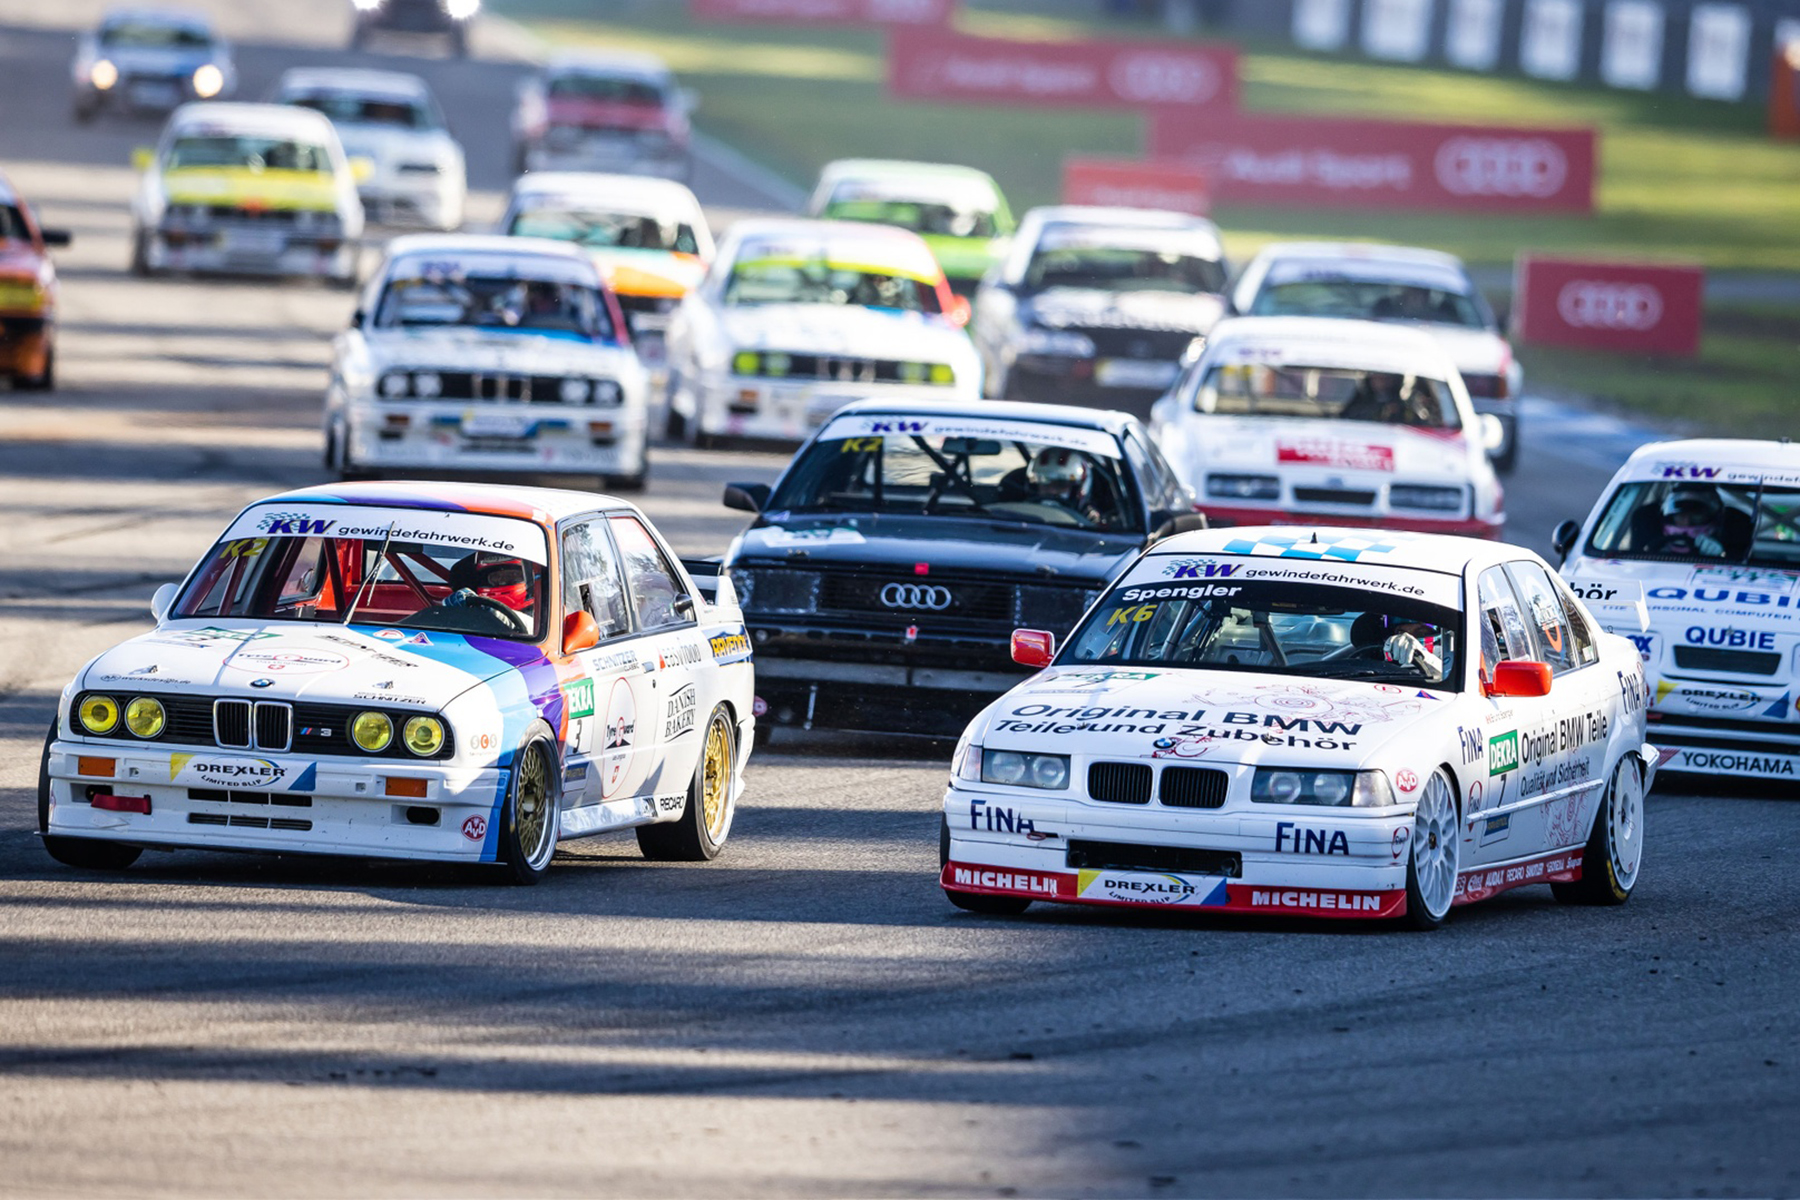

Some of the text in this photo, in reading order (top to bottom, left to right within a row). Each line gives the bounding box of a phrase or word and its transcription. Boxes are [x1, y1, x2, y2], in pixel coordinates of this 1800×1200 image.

[841, 436, 884, 453] K2
[267, 519, 515, 551] KW gewindefahrwerk.de
[219, 538, 269, 559] K2
[1173, 564, 1426, 597] KW gewindefahrwerk.de
[1122, 584, 1242, 602] Spengler
[1647, 587, 1800, 609] QUBI
[1106, 605, 1158, 626] K6
[1685, 626, 1777, 650] QUBIE
[592, 650, 638, 672] SCHNITZER
[667, 689, 696, 718] DANISH
[1681, 688, 1763, 702] DREXLER
[664, 708, 696, 738] BAKERY
[1012, 704, 1363, 736] Original BMW
[573, 719, 583, 754] 3
[994, 719, 1358, 751] Teile und Zubehör
[1457, 725, 1484, 765] FINA
[1521, 709, 1608, 767] Original BMW Teile
[1490, 737, 1518, 770] DEKRA
[1682, 751, 1795, 775] YOKOHAMA
[194, 763, 288, 777] DREXLER
[201, 775, 262, 787] LIMITED SLIP
[660, 796, 685, 812] RECARO
[970, 799, 1036, 834] FINA
[1275, 822, 1350, 856] FINA
[955, 868, 1058, 896] MICHELIN
[1506, 866, 1525, 882] RECARO
[1104, 879, 1195, 894] DREXLER
[1252, 890, 1381, 911] MICHELIN
